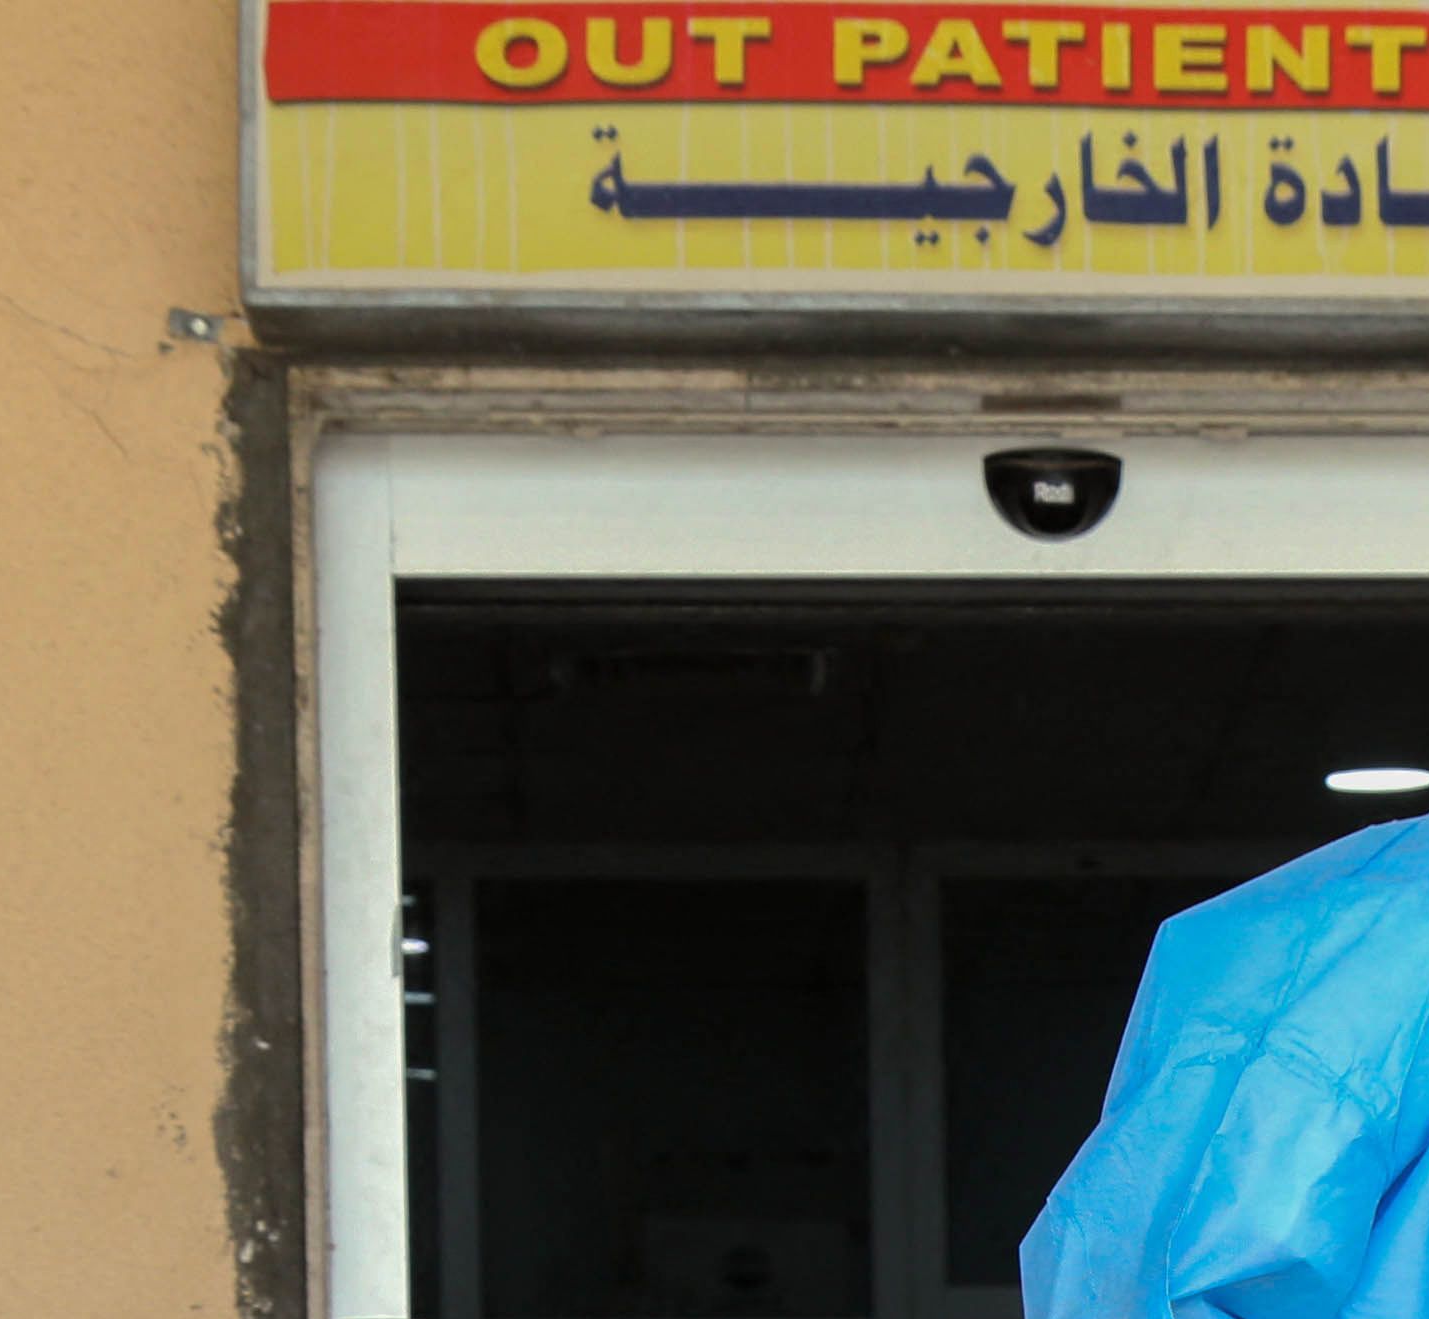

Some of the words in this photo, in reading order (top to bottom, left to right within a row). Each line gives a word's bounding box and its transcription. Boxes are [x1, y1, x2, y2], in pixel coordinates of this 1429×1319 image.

[475, 17, 771, 88] OUT
[833, 18, 1428, 94] PATIENT
[589, 124, 1221, 248] الخارجية
